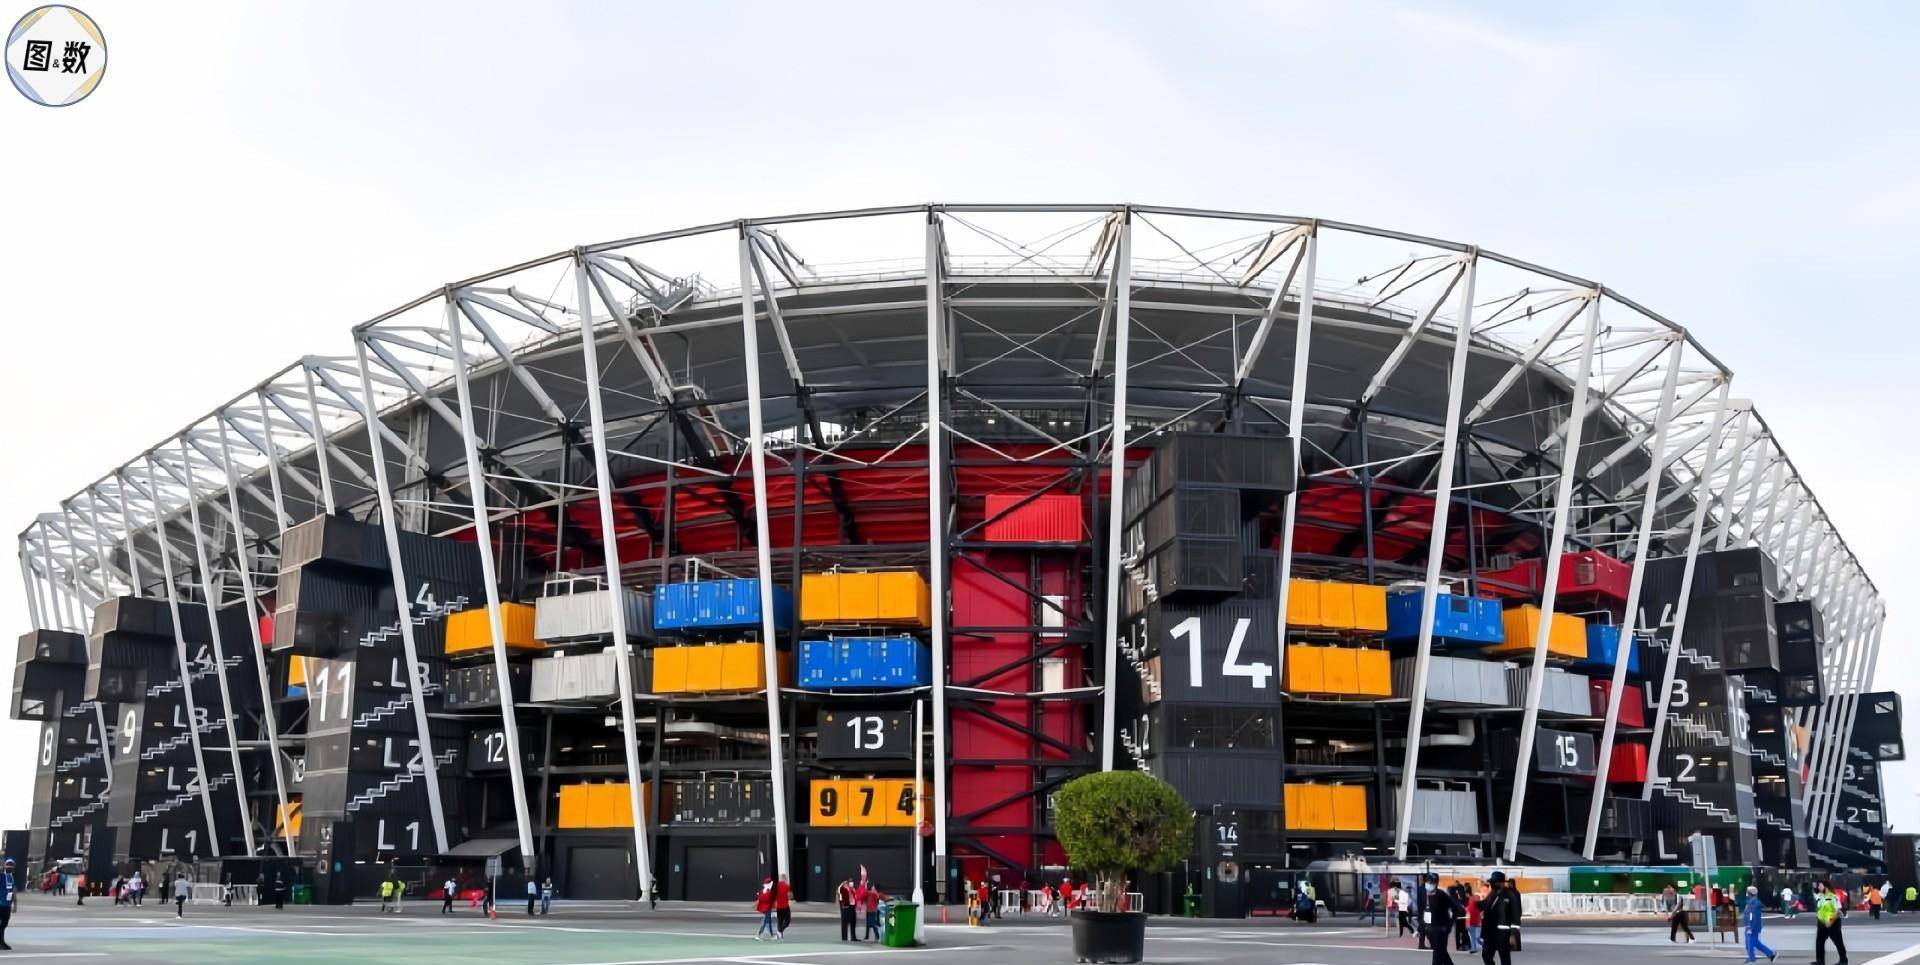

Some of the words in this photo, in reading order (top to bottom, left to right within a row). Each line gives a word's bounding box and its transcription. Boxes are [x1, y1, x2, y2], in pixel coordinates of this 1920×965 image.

[1170, 617, 1272, 688] 14
[316, 662, 351, 722] 11
[1645, 679, 1690, 708] L3
[43, 727, 54, 766] 8
[123, 709, 136, 754] 9
[484, 732, 505, 762] 12
[846, 716, 884, 750] 13
[383, 738, 424, 770] L2
[1556, 735, 1578, 767] 15
[161, 828, 197, 854] L1
[378, 820, 419, 850] L1
[1217, 826, 1238, 841] 14
